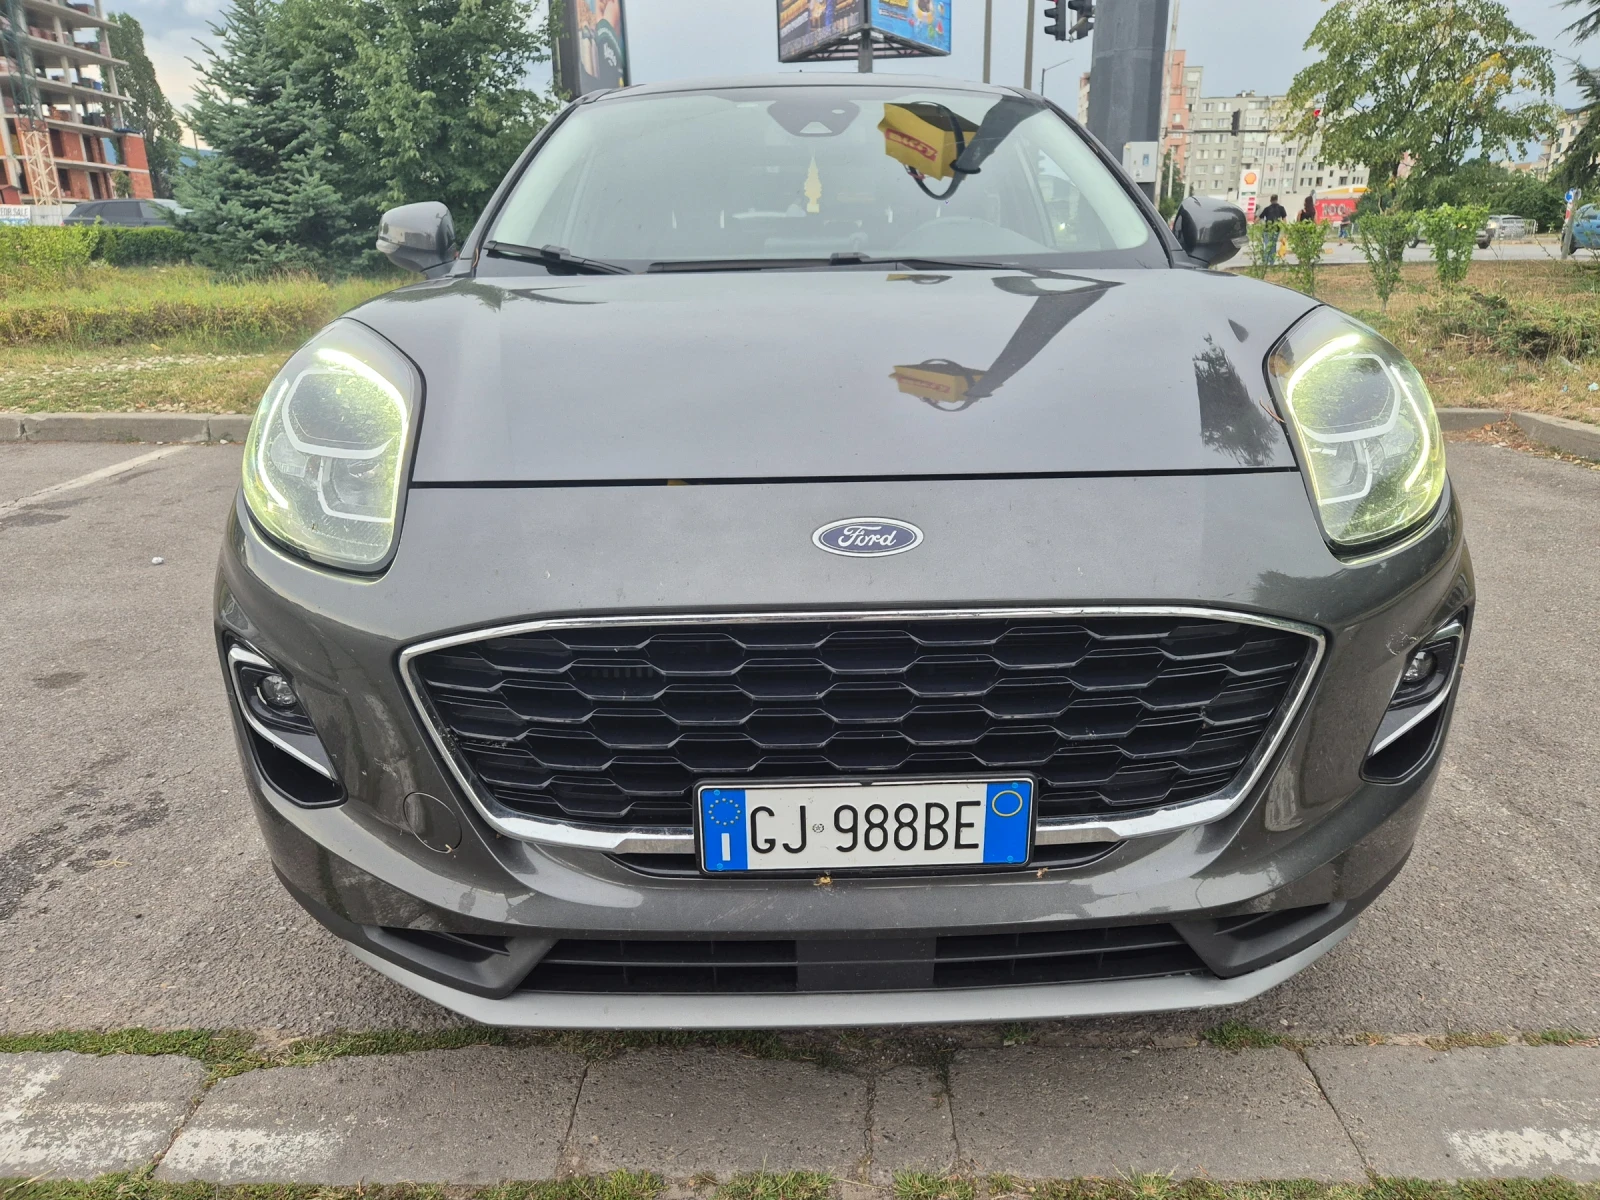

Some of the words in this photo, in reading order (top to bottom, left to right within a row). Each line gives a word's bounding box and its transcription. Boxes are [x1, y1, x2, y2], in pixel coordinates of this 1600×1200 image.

[837, 525, 897, 547] Ford
[750, 805, 808, 854] GJ
[833, 800, 982, 852] 988BE
